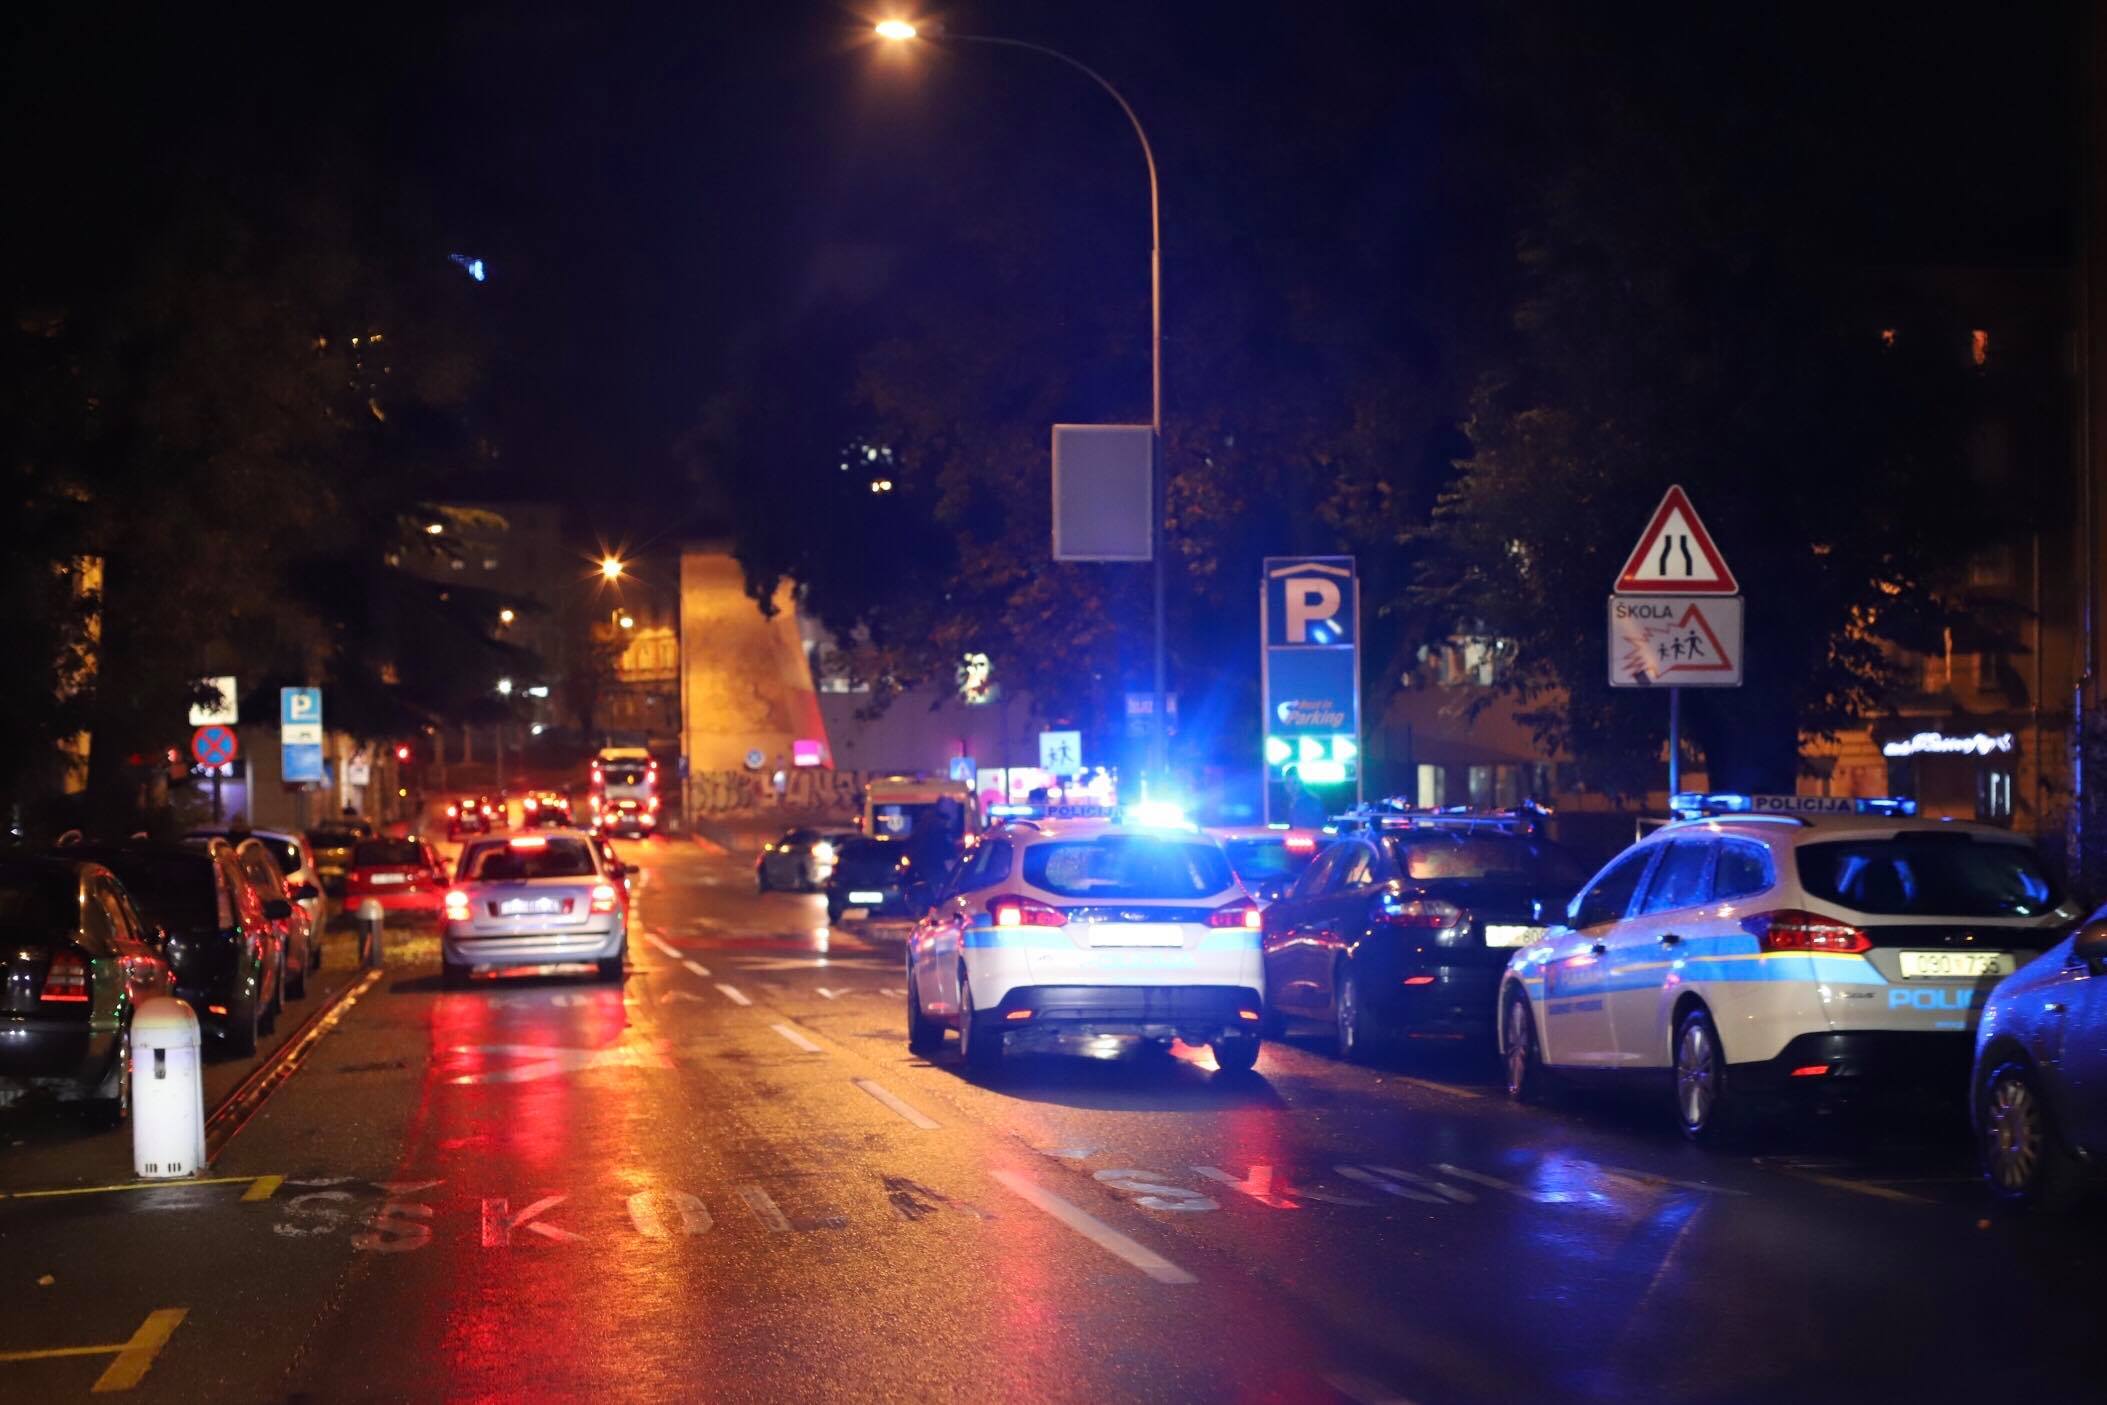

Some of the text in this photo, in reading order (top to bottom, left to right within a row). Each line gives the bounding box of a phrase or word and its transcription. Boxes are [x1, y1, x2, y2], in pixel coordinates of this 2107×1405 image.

[1285, 578, 1341, 643] P
[1616, 602, 1673, 619] ŠKOLA
[291, 694, 311, 720] P
[1048, 806, 1124, 816] POLICIJA
[1755, 797, 1851, 811] POLICIJA
